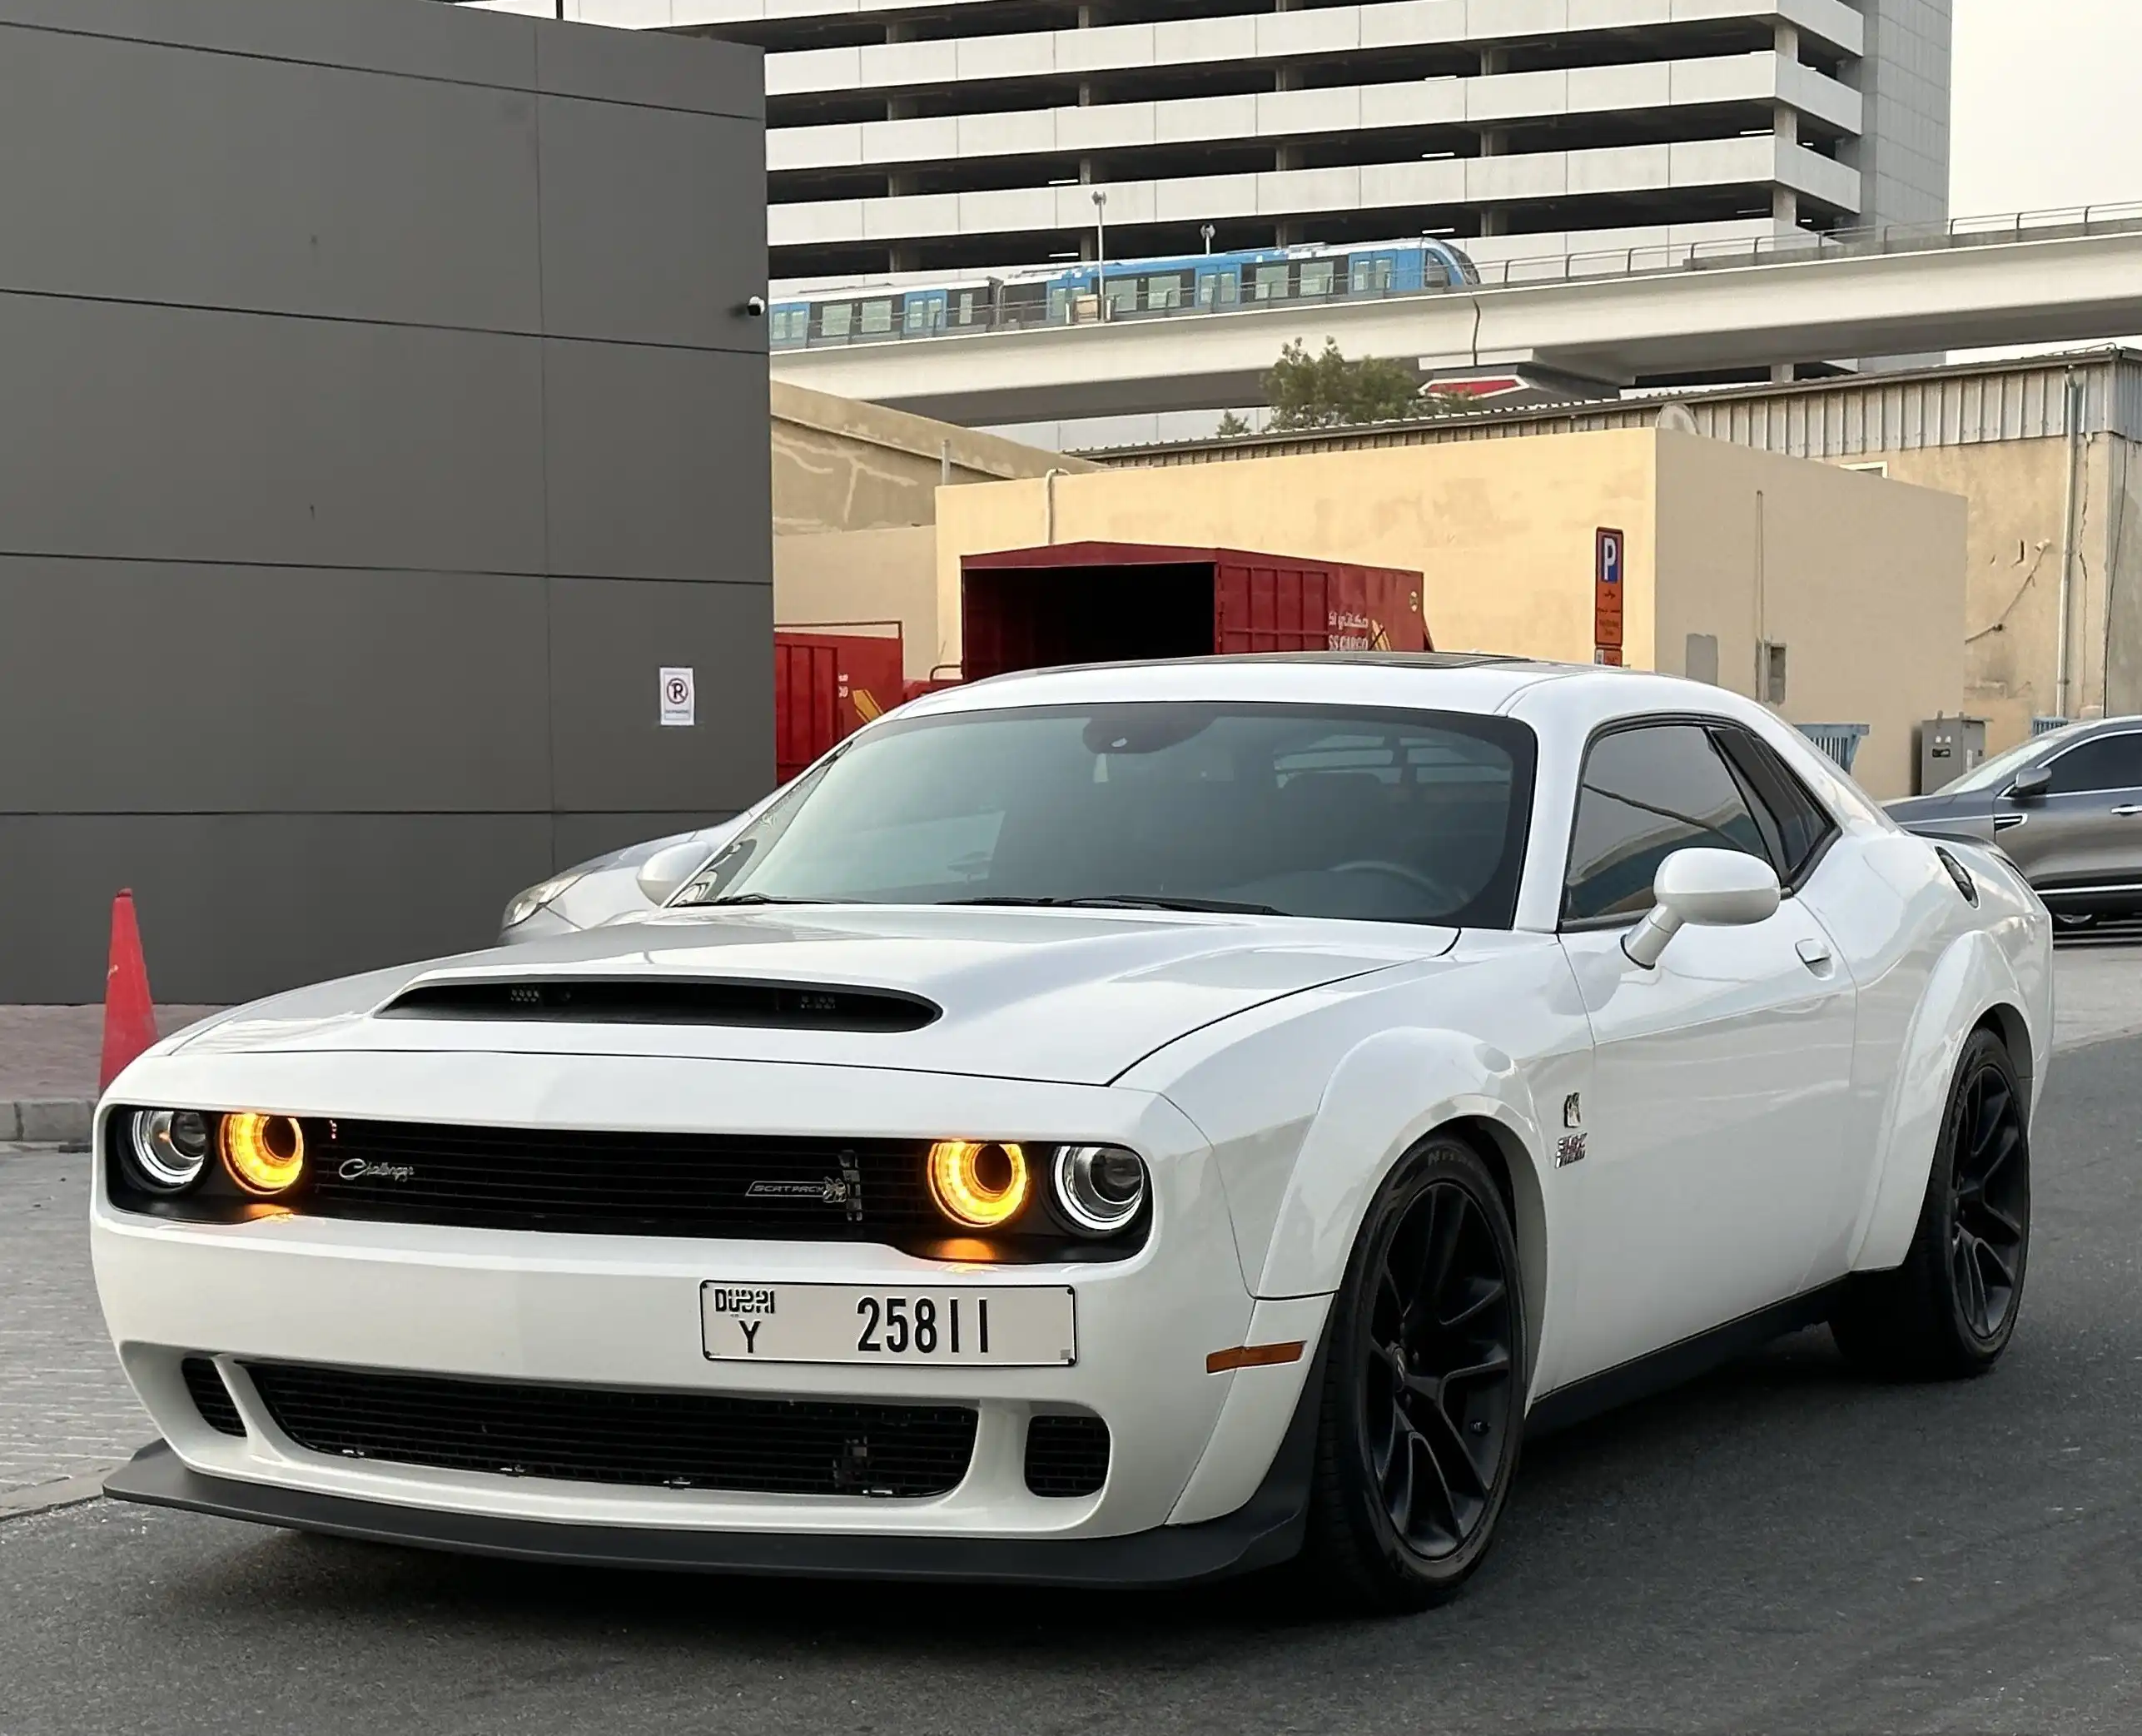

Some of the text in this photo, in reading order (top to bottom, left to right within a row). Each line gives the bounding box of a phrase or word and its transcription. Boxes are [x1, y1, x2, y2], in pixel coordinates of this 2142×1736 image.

[1603, 537, 1617, 581] P
[738, 1296, 989, 1355] Y 25811
